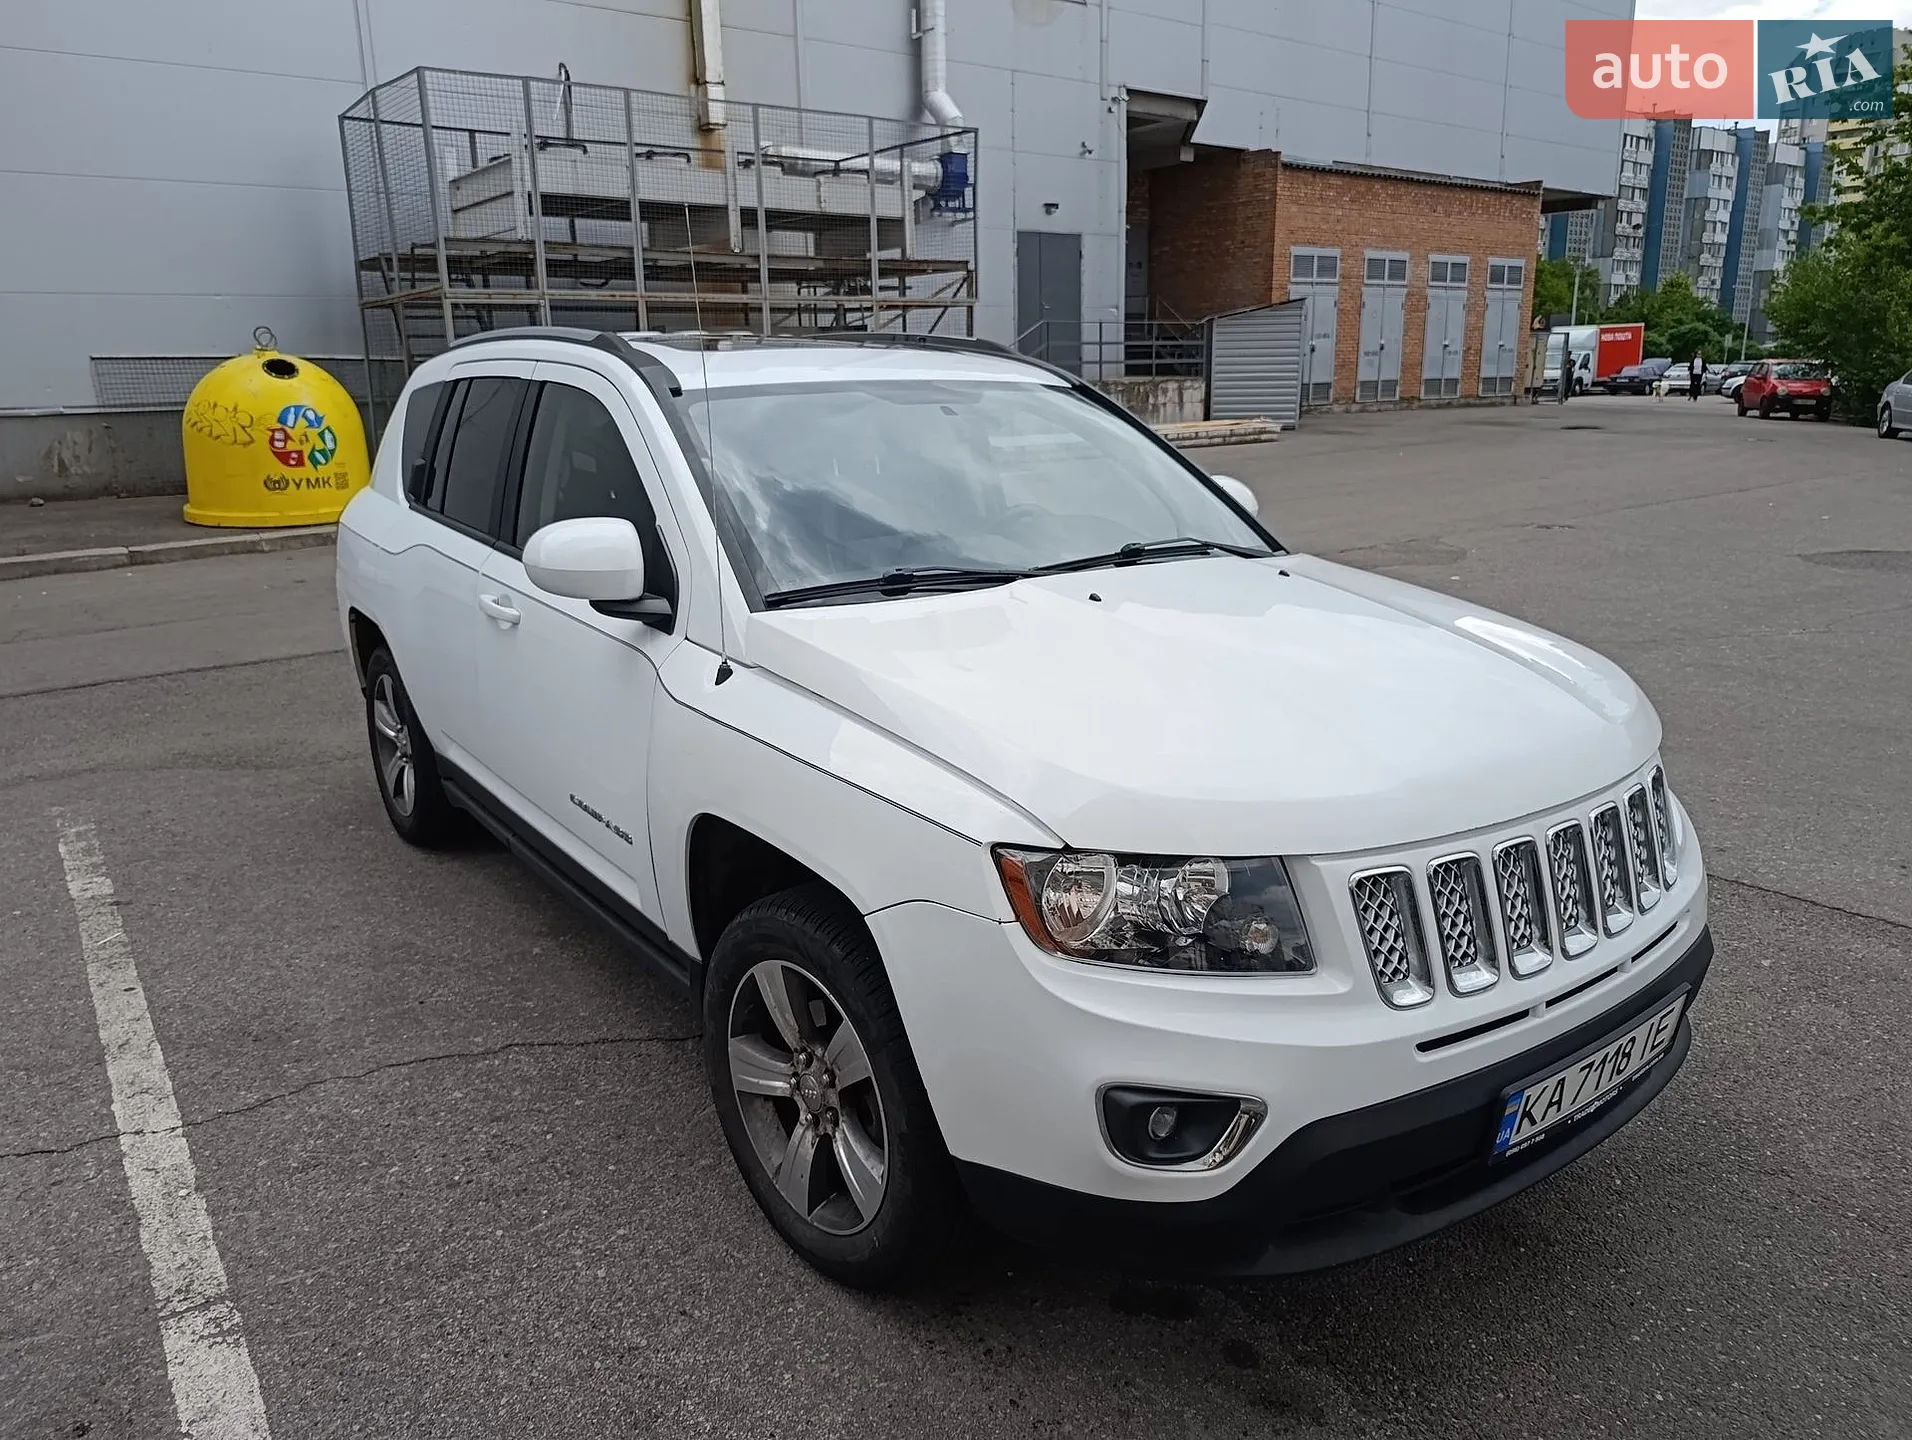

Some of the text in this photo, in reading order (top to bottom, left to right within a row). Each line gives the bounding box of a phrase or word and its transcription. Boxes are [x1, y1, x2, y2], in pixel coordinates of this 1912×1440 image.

[1515, 1076, 1567, 1135] KA
[1571, 1036, 1637, 1105] 7118
[1640, 1006, 1676, 1060] IE
[1496, 1127, 1511, 1144] UA
